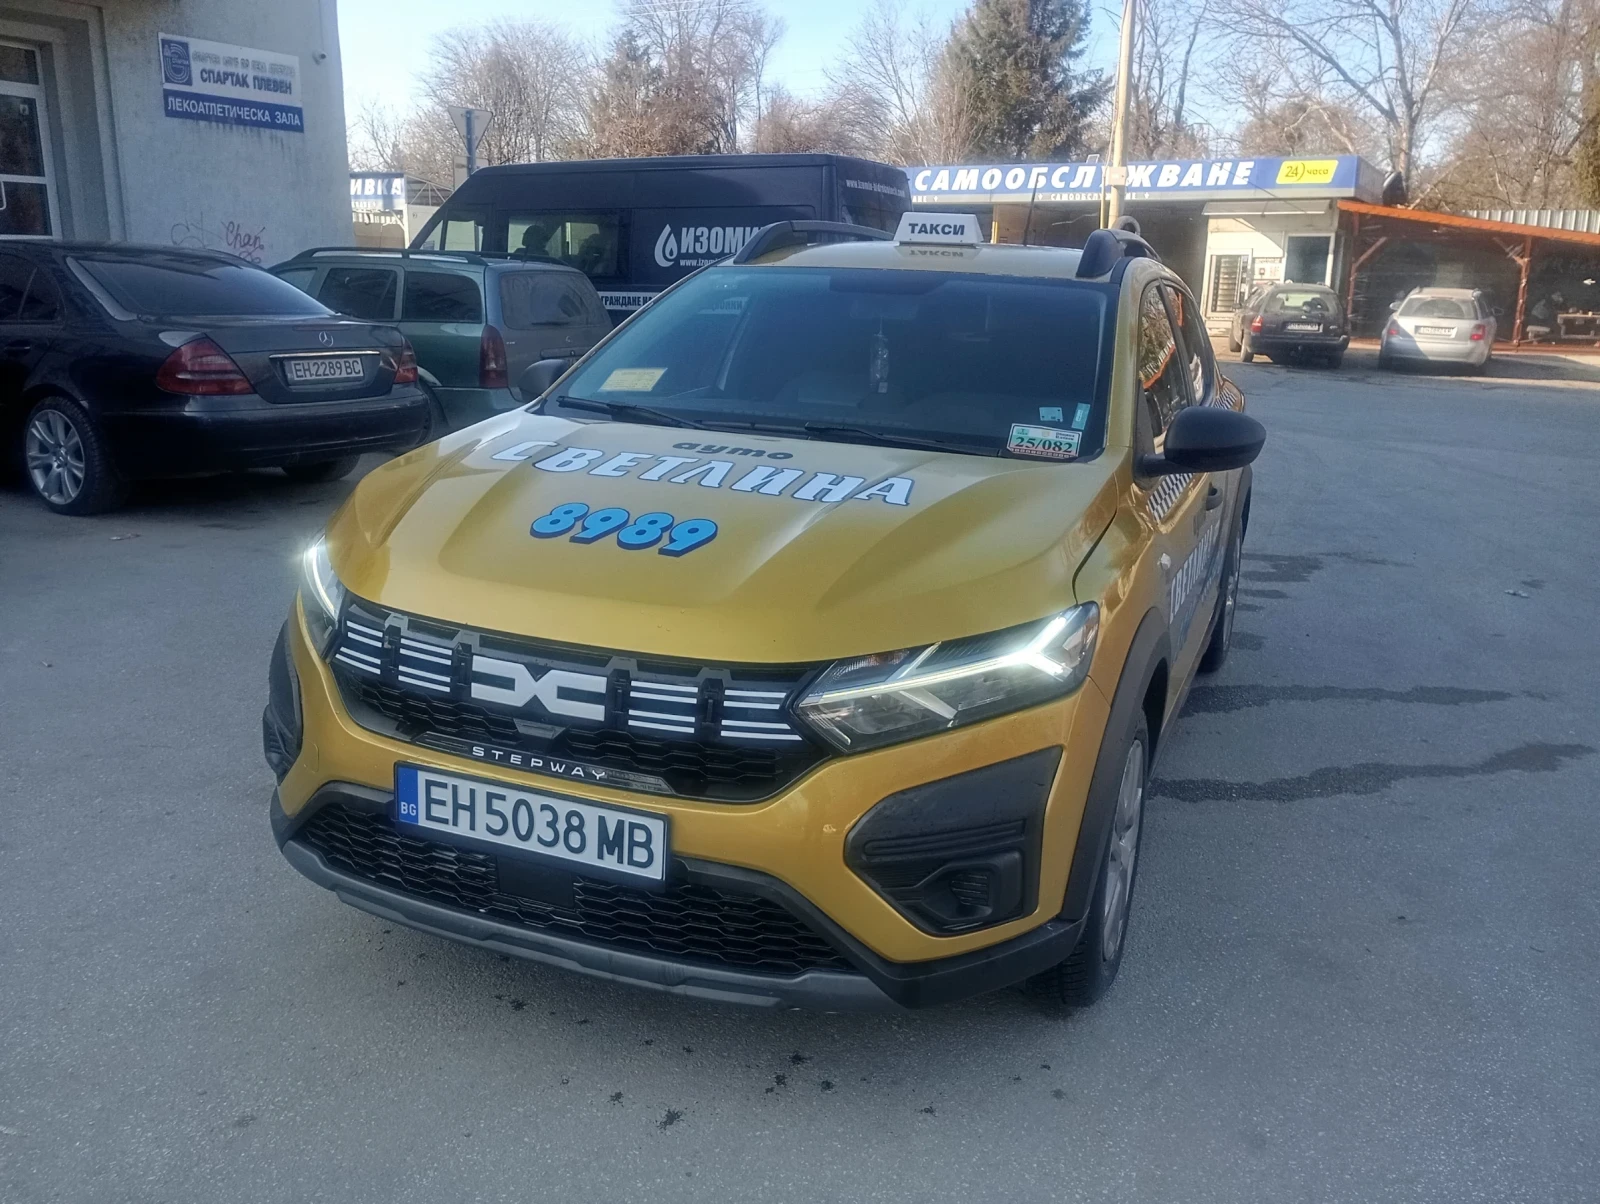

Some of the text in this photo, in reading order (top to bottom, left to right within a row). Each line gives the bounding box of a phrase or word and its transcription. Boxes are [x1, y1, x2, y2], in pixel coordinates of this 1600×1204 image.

[200, 68, 292, 95] СПАРТАК ПЛЕВЕН
[168, 97, 301, 125] ЛЕКОАТЛЕТИЧЕСКА ЗАЛА
[914, 161, 1255, 191] САМООБСЛЖВАНЕ
[908, 223, 965, 236] ТАКСИ
[313, 361, 342, 377] 2289
[1015, 437, 1073, 453] 25/082
[489, 440, 915, 507] СВЕТЛИНА
[529, 502, 719, 558] 8989
[472, 746, 606, 780] STEPWAY
[400, 802, 417, 818] BG
[485, 790, 588, 855] 5038
